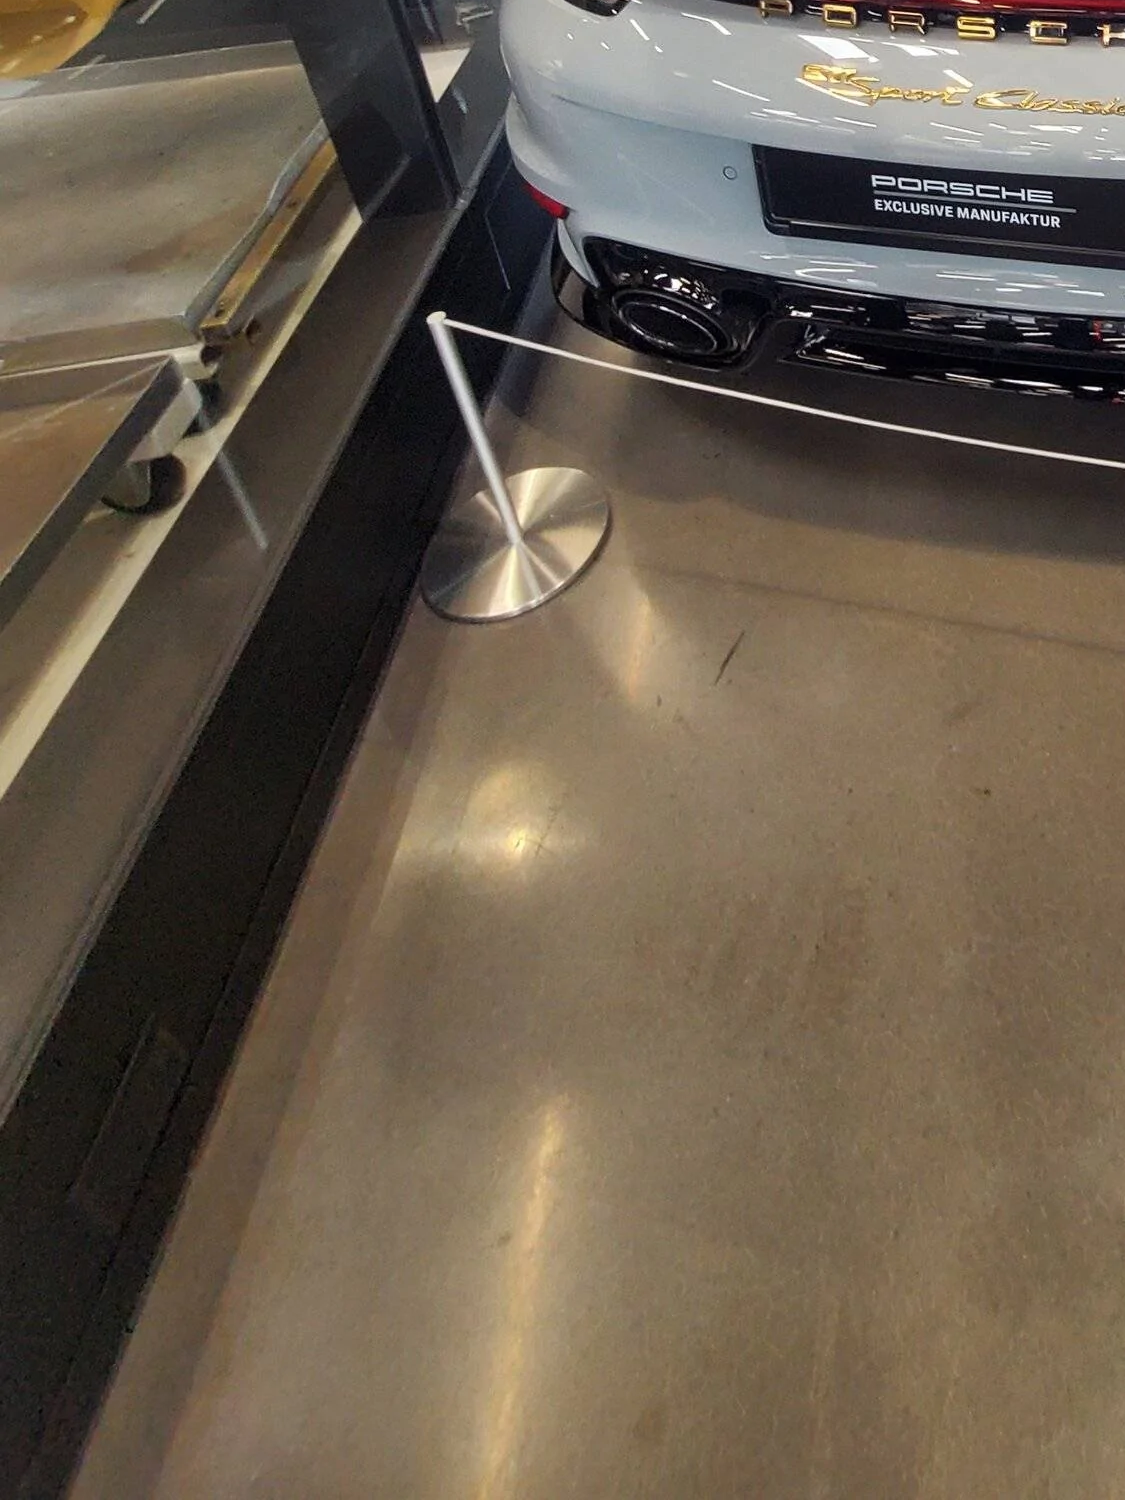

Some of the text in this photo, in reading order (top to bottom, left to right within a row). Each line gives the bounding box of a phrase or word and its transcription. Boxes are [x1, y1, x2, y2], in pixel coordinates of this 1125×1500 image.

[827, 73, 973, 107] Sport
[871, 174, 1055, 204] PORSCHE
[874, 198, 1062, 229] EXCLUSIVE MANUFAKTUR
